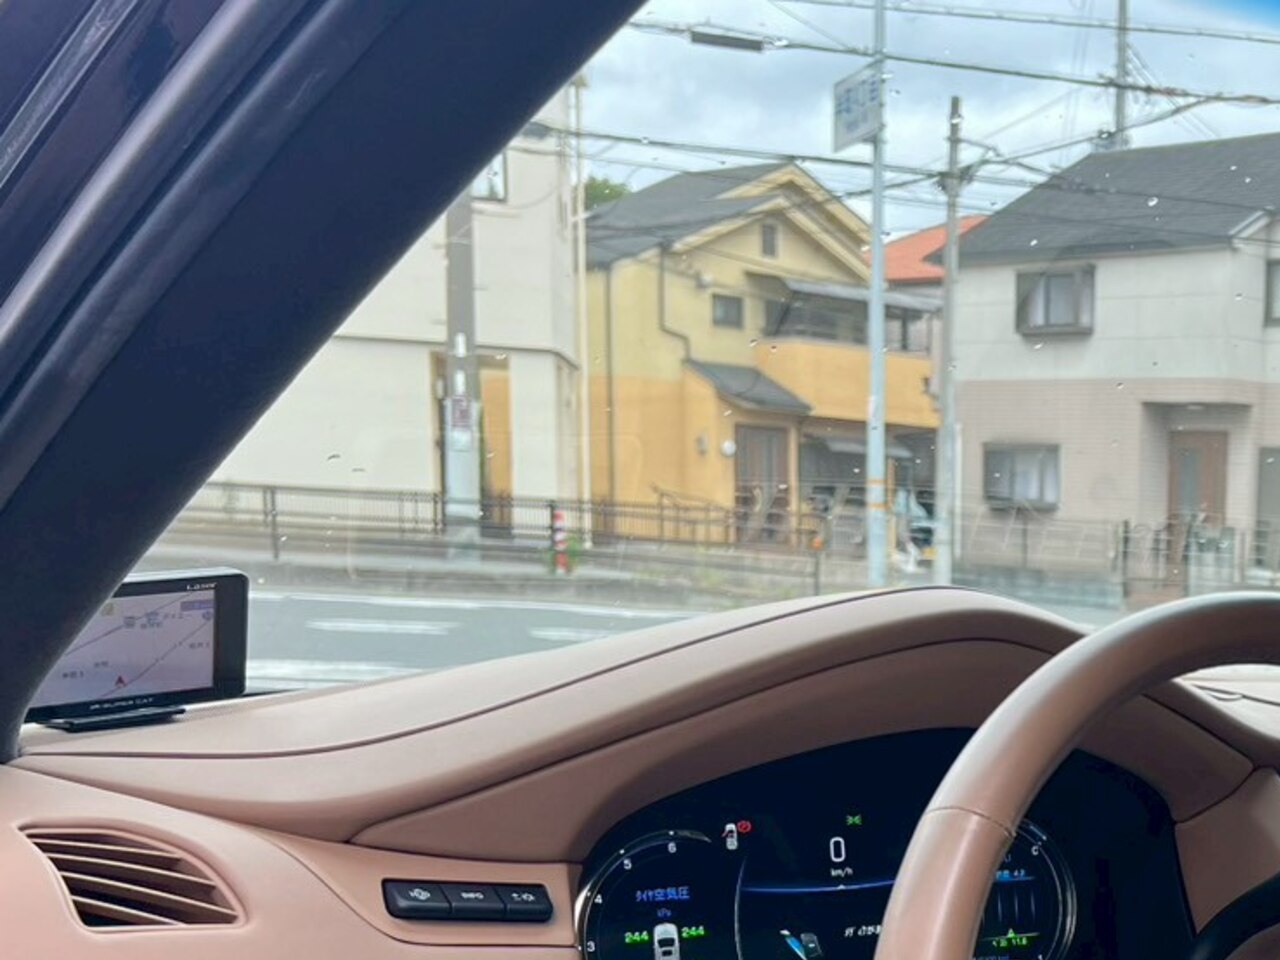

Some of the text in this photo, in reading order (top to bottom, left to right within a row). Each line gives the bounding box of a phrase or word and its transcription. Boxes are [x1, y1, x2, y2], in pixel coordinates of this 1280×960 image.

[668, 842, 677, 853] 6
[829, 836, 846, 862] 0
[623, 859, 632, 870] 5
[830, 867, 853, 877] km/h
[594, 894, 603, 904] 4
[624, 931, 649, 944] 244
[681, 925, 705, 939] 244
[586, 941, 596, 952] 3
